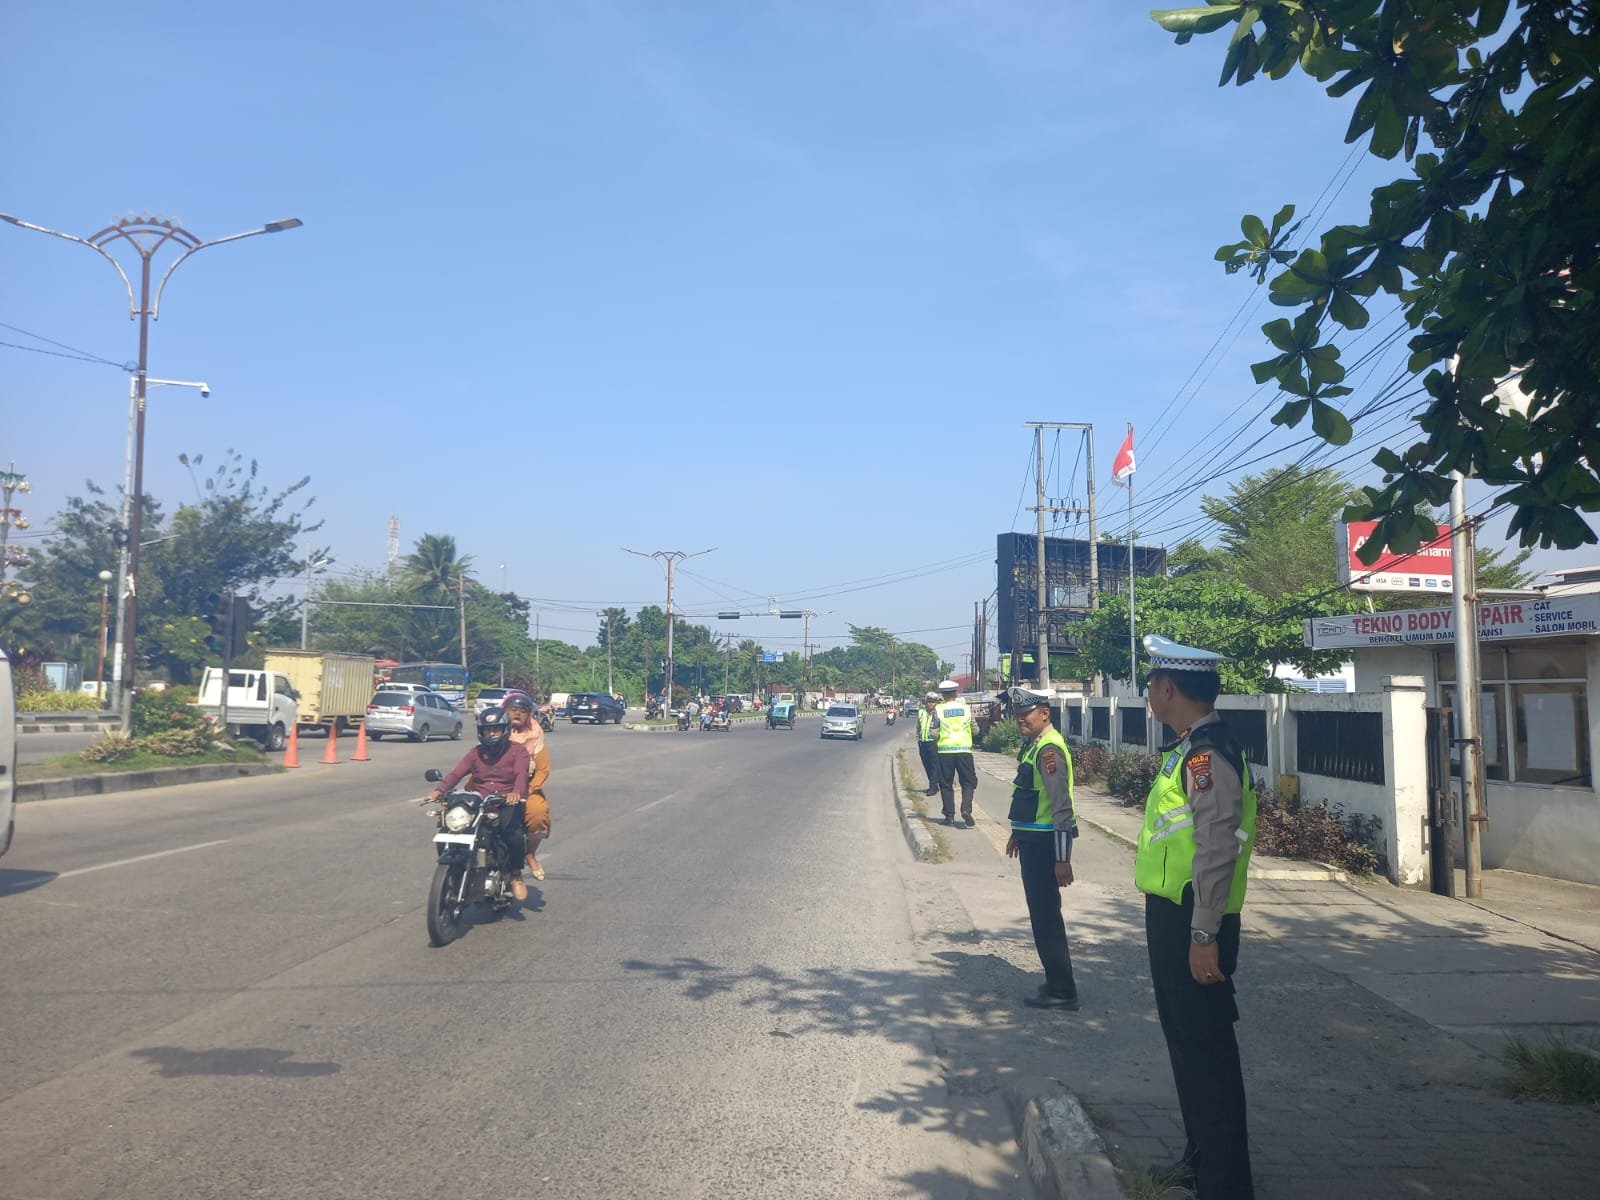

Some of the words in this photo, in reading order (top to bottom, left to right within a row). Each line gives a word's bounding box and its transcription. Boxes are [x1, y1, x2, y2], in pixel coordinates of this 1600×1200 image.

[1534, 601, 1551, 611] CAT
[1353, 614, 1403, 634] TEKNO
[1408, 610, 1452, 631] BODY
[1477, 604, 1524, 626] PAIR
[1534, 610, 1573, 622] SERVICE
[1535, 622, 1565, 633] SALON
[1567, 620, 1597, 630] MOBIL
[1369, 634, 1405, 644] BENGKEL
[1406, 633, 1433, 641] UMUM
[1436, 631, 1455, 640] DAN
